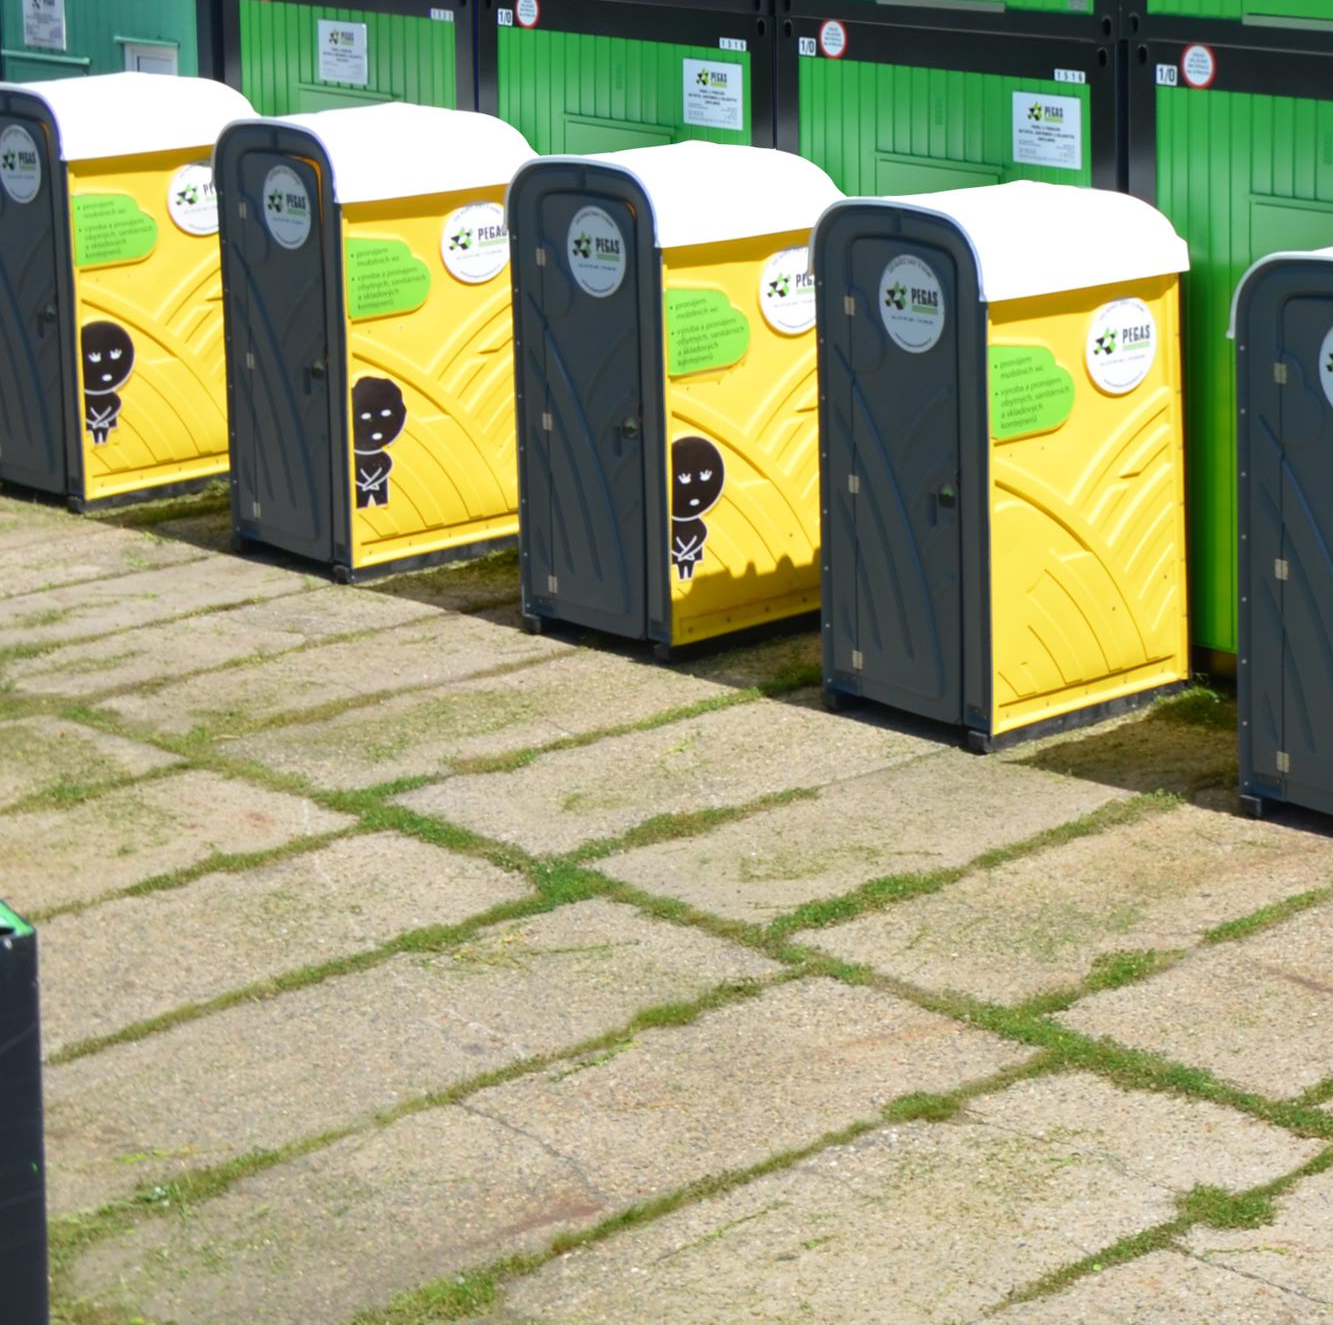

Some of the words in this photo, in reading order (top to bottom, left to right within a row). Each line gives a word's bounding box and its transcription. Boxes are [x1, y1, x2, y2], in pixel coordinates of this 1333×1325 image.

[801, 39, 815, 55] 1/0
[710, 71, 728, 84] PEGAS
[1158, 66, 1176, 84] 1/0
[1044, 105, 1064, 119] PEGAS
[286, 193, 306, 210] PEGAS
[595, 237, 620, 254] PEGAS
[911, 288, 938, 307] PEGAS
[1122, 324, 1151, 344] PEGAS
